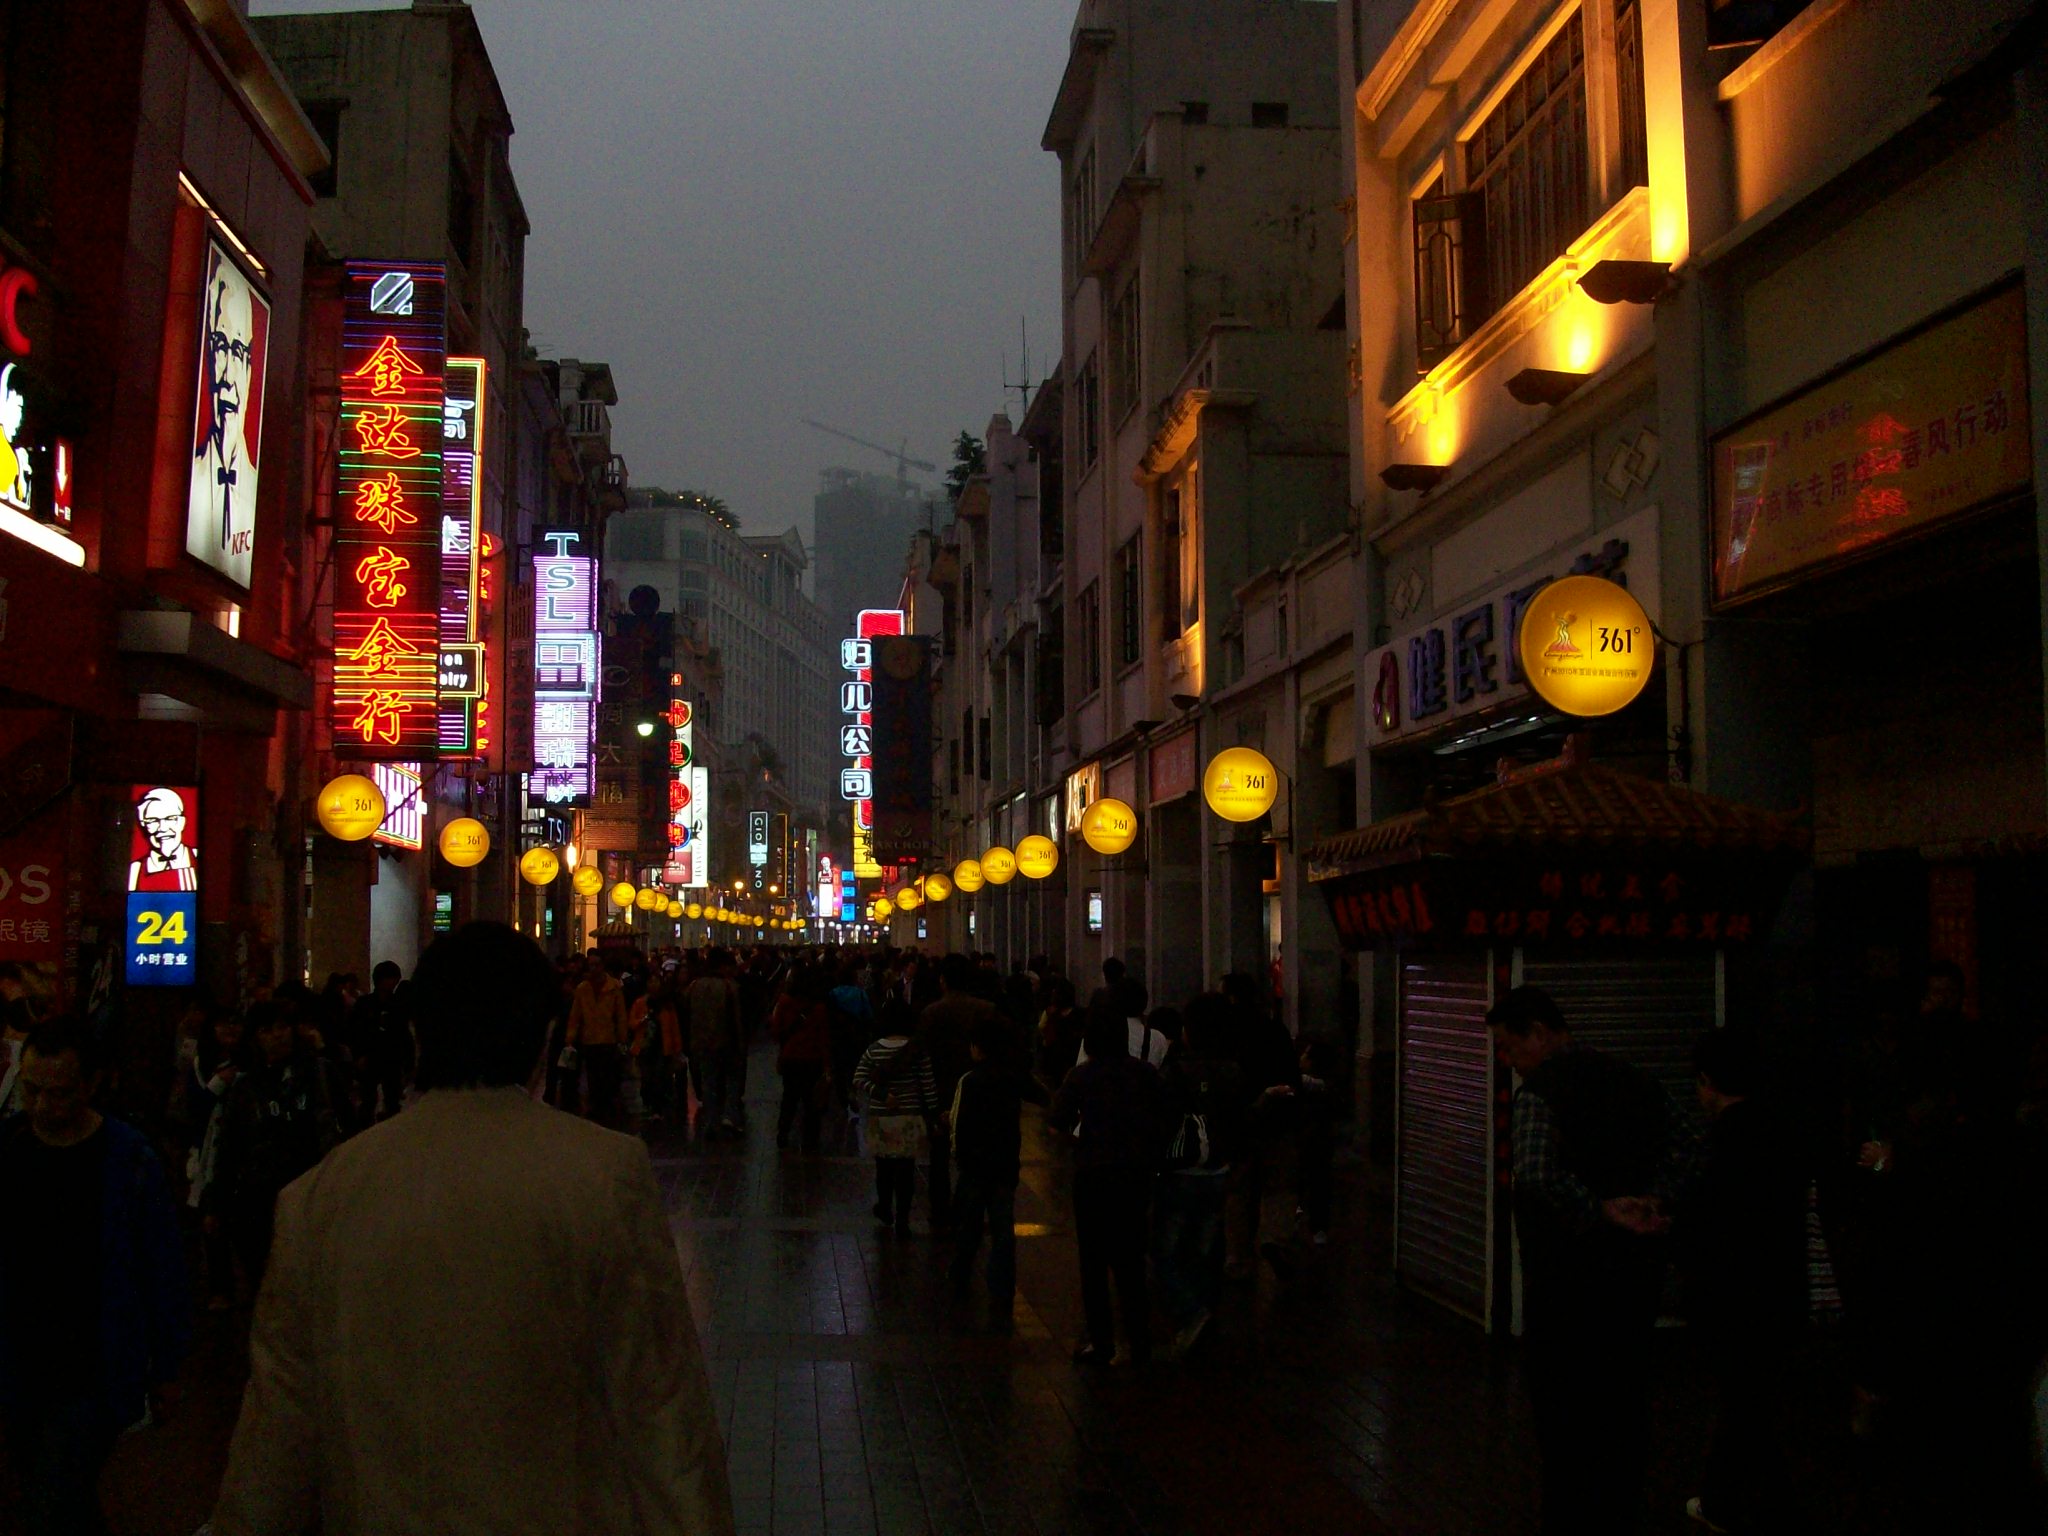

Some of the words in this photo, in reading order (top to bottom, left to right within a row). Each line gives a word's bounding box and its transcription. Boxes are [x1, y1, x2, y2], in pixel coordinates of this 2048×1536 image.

[231, 529, 251, 556] KFC
[351, 335, 425, 745] 金达珠宝金行
[544, 531, 580, 622] TSL
[844, 641, 872, 797] 妇儿公司
[548, 817, 567, 846] TSL
[136, 910, 188, 945] 24
[135, 952, 188, 966] 小时营业
